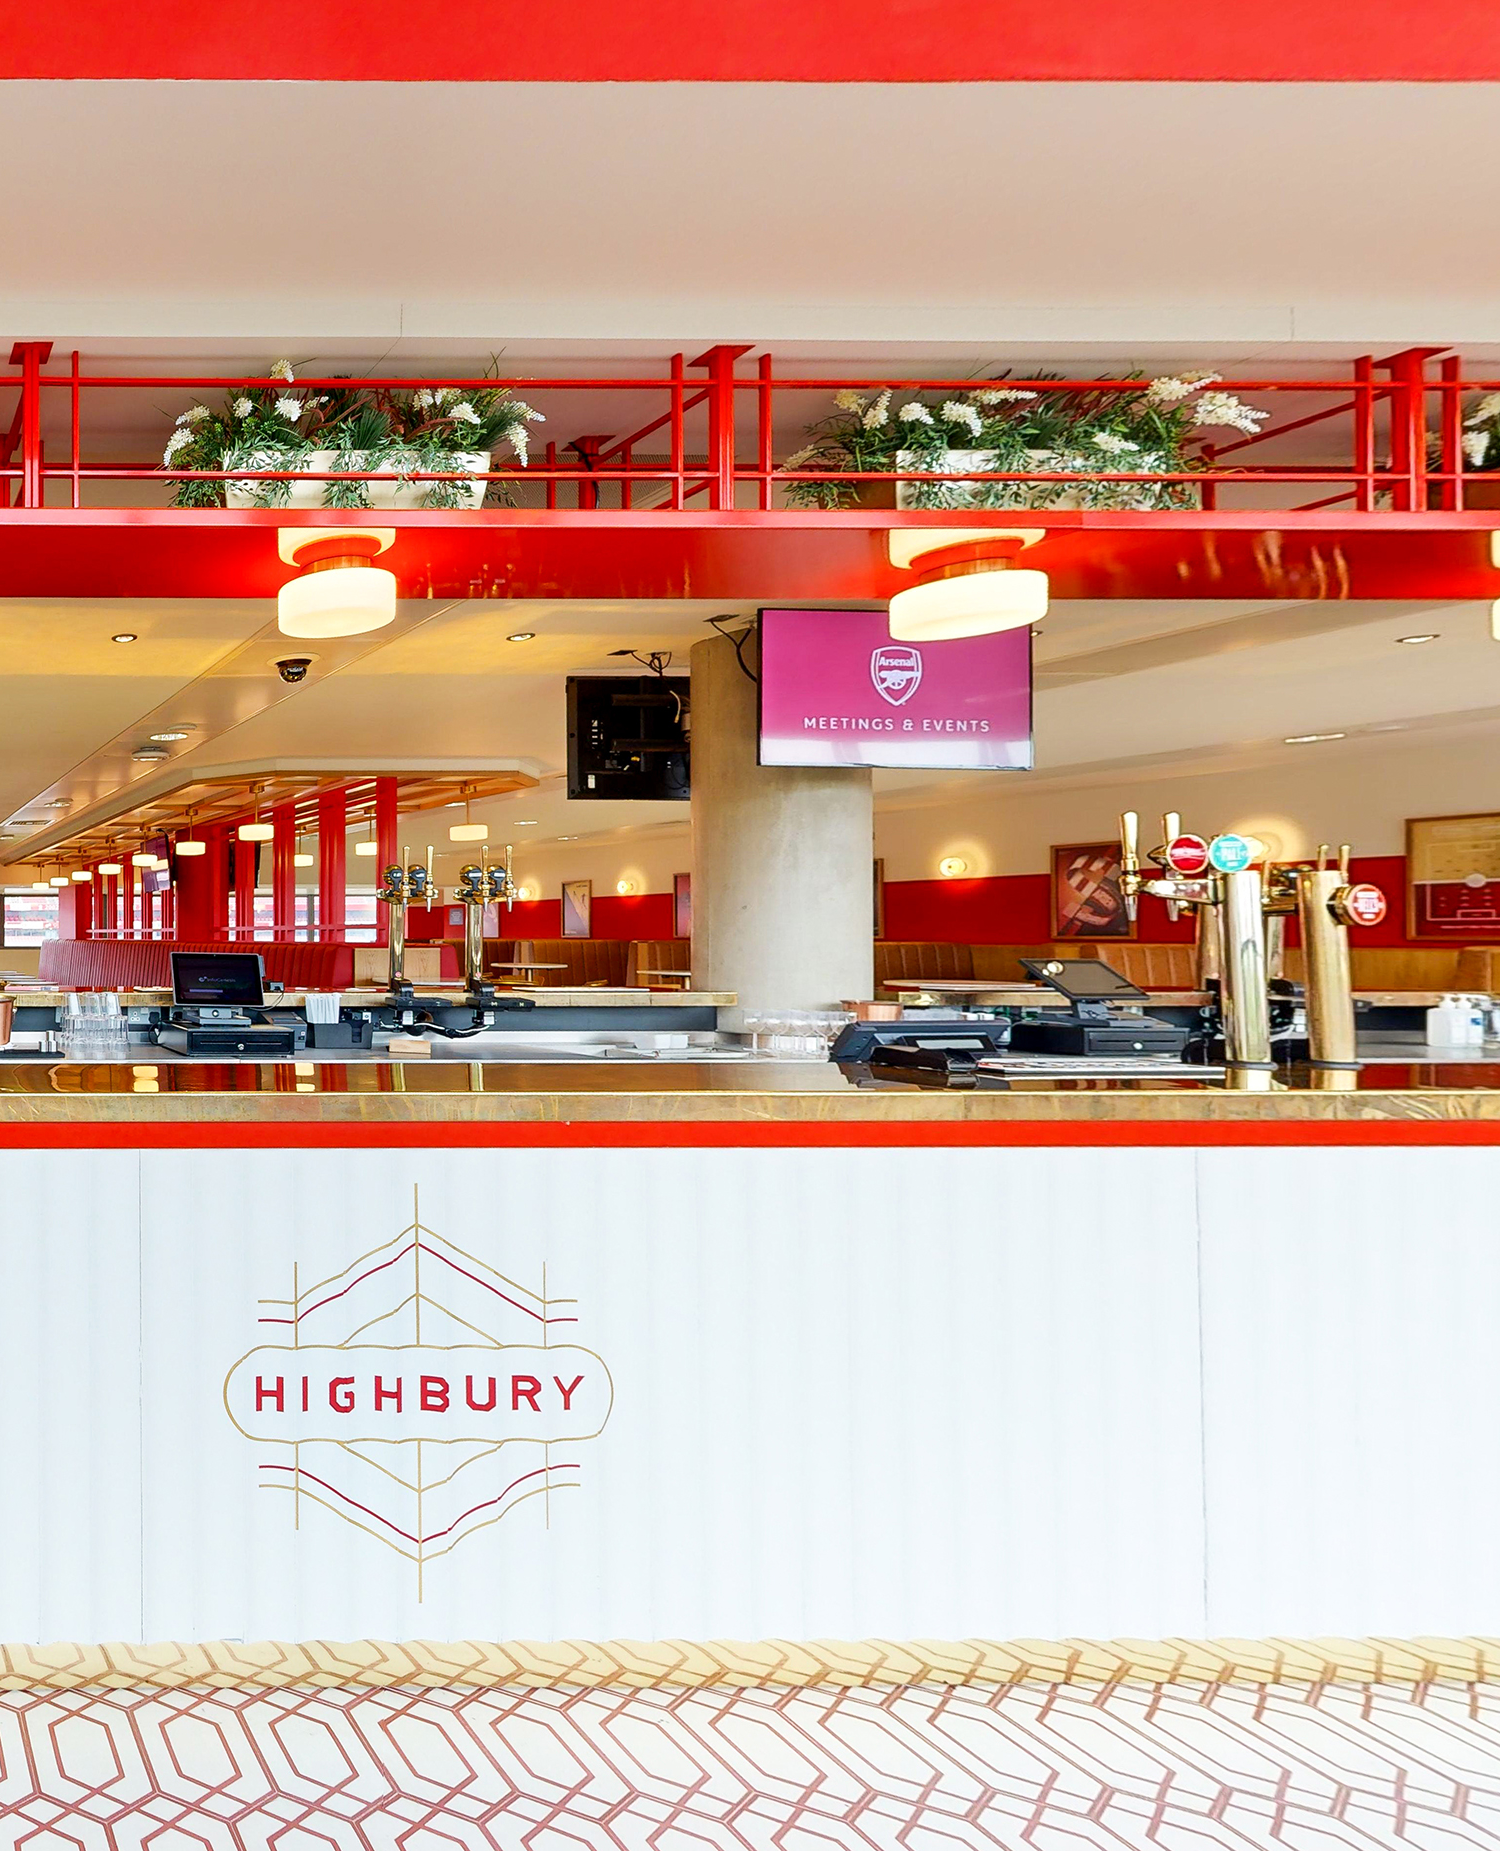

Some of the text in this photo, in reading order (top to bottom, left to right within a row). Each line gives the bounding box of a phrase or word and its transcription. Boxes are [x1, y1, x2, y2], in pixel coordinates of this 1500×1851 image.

[879, 656, 915, 667] Arsenal
[803, 717, 990, 732] MEETINGS & EVENTS
[255, 1375, 585, 1413] HIGHBURY
